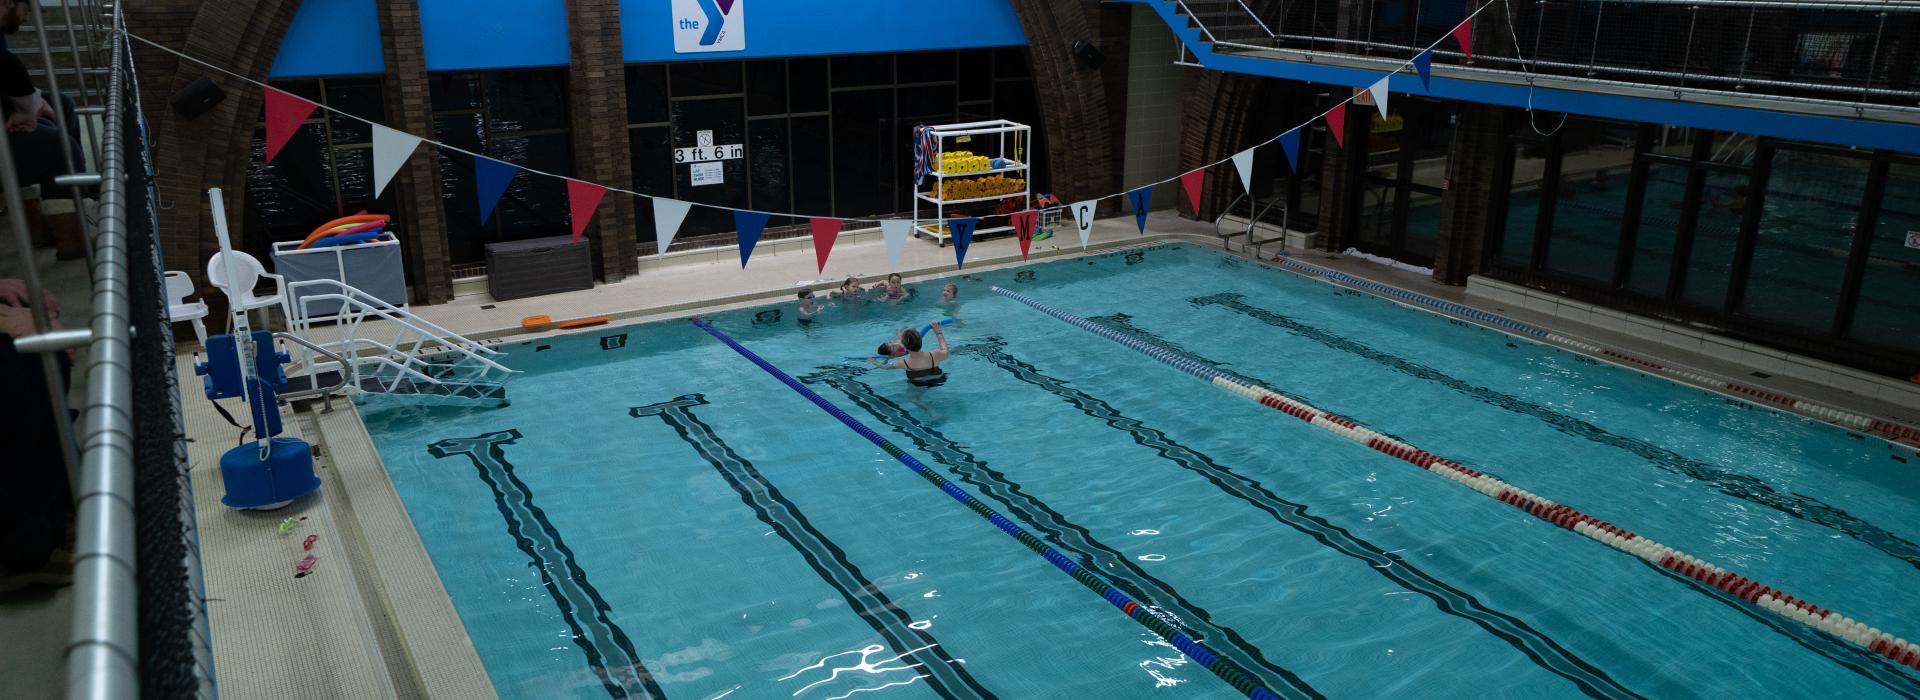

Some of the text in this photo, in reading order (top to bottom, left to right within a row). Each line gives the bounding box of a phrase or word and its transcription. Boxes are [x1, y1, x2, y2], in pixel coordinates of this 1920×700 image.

[680, 18, 699, 30] the
[675, 145, 743, 162] 3 ft. 6 in
[956, 192, 1145, 249] Y M C A
